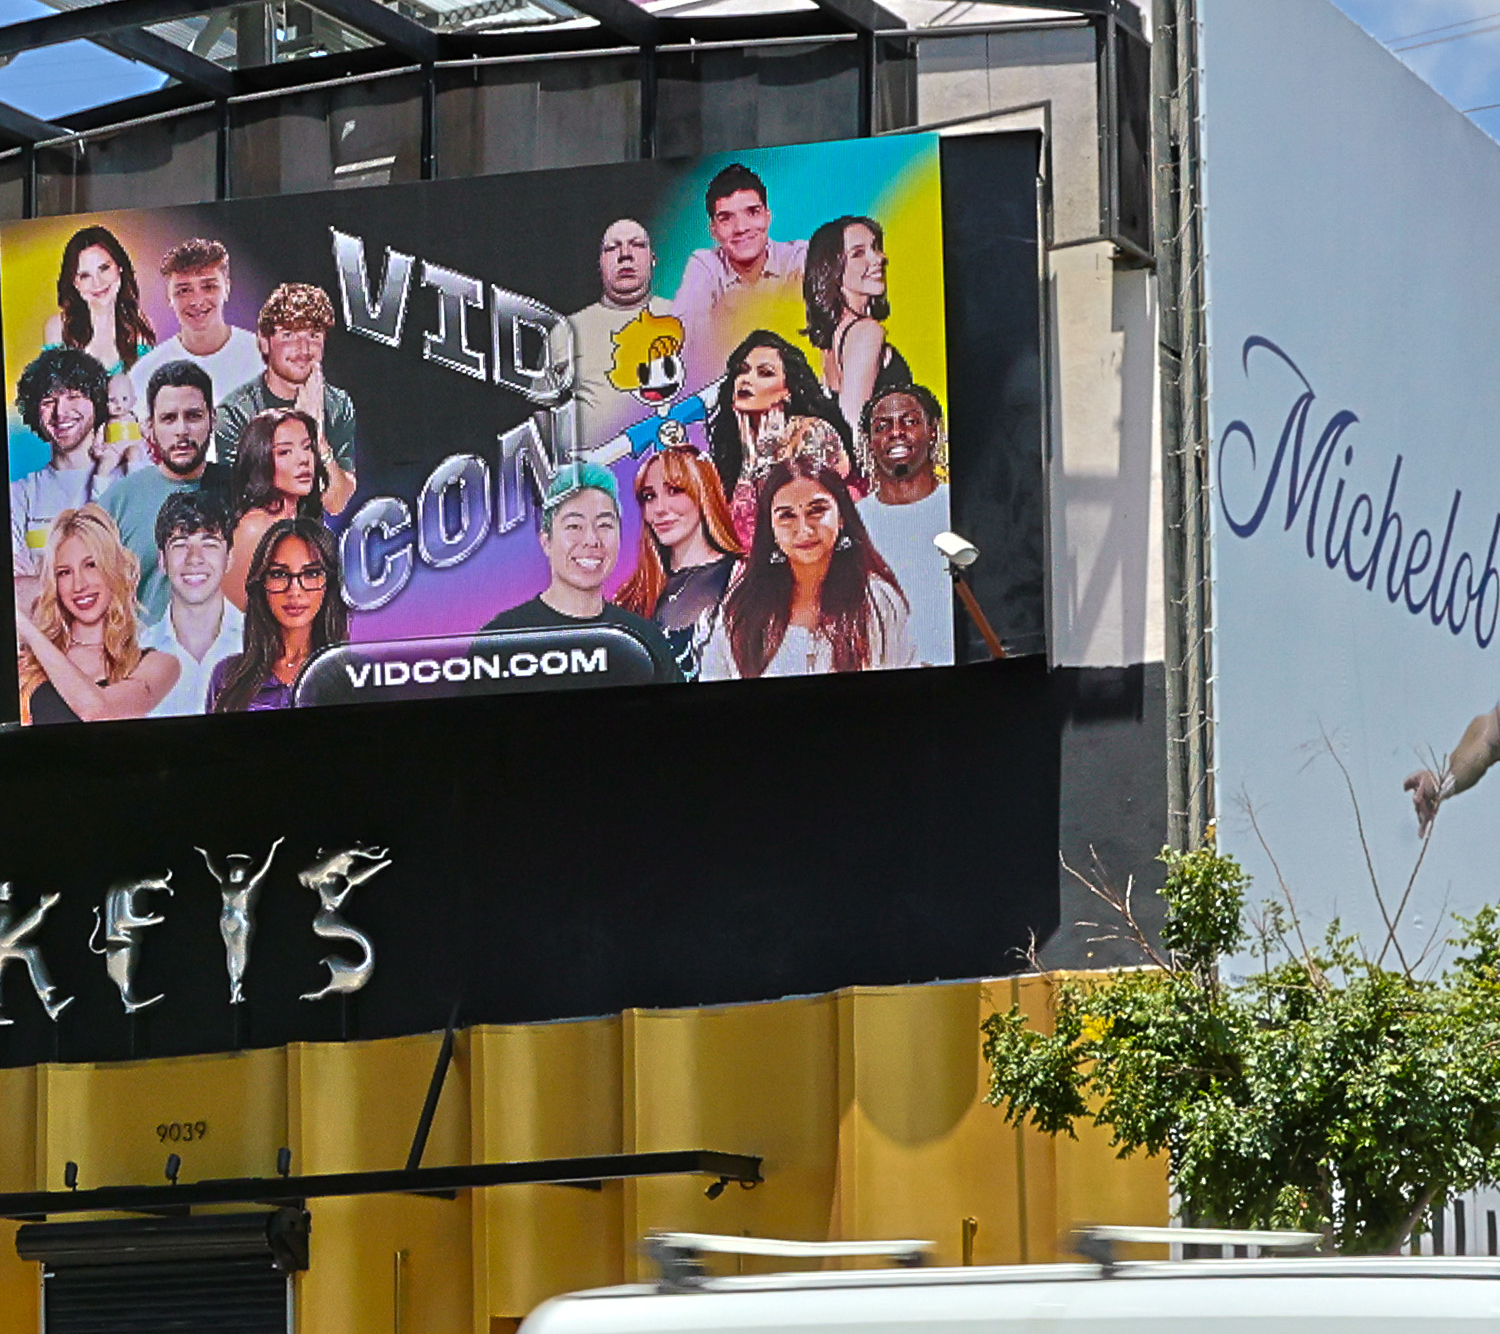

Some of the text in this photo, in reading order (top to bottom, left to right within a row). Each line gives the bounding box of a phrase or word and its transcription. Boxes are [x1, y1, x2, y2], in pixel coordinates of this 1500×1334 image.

[329, 226, 580, 612] VID CON
[346, 647, 609, 688] VIDCON.COM
[156, 1121, 207, 1143] 9039
